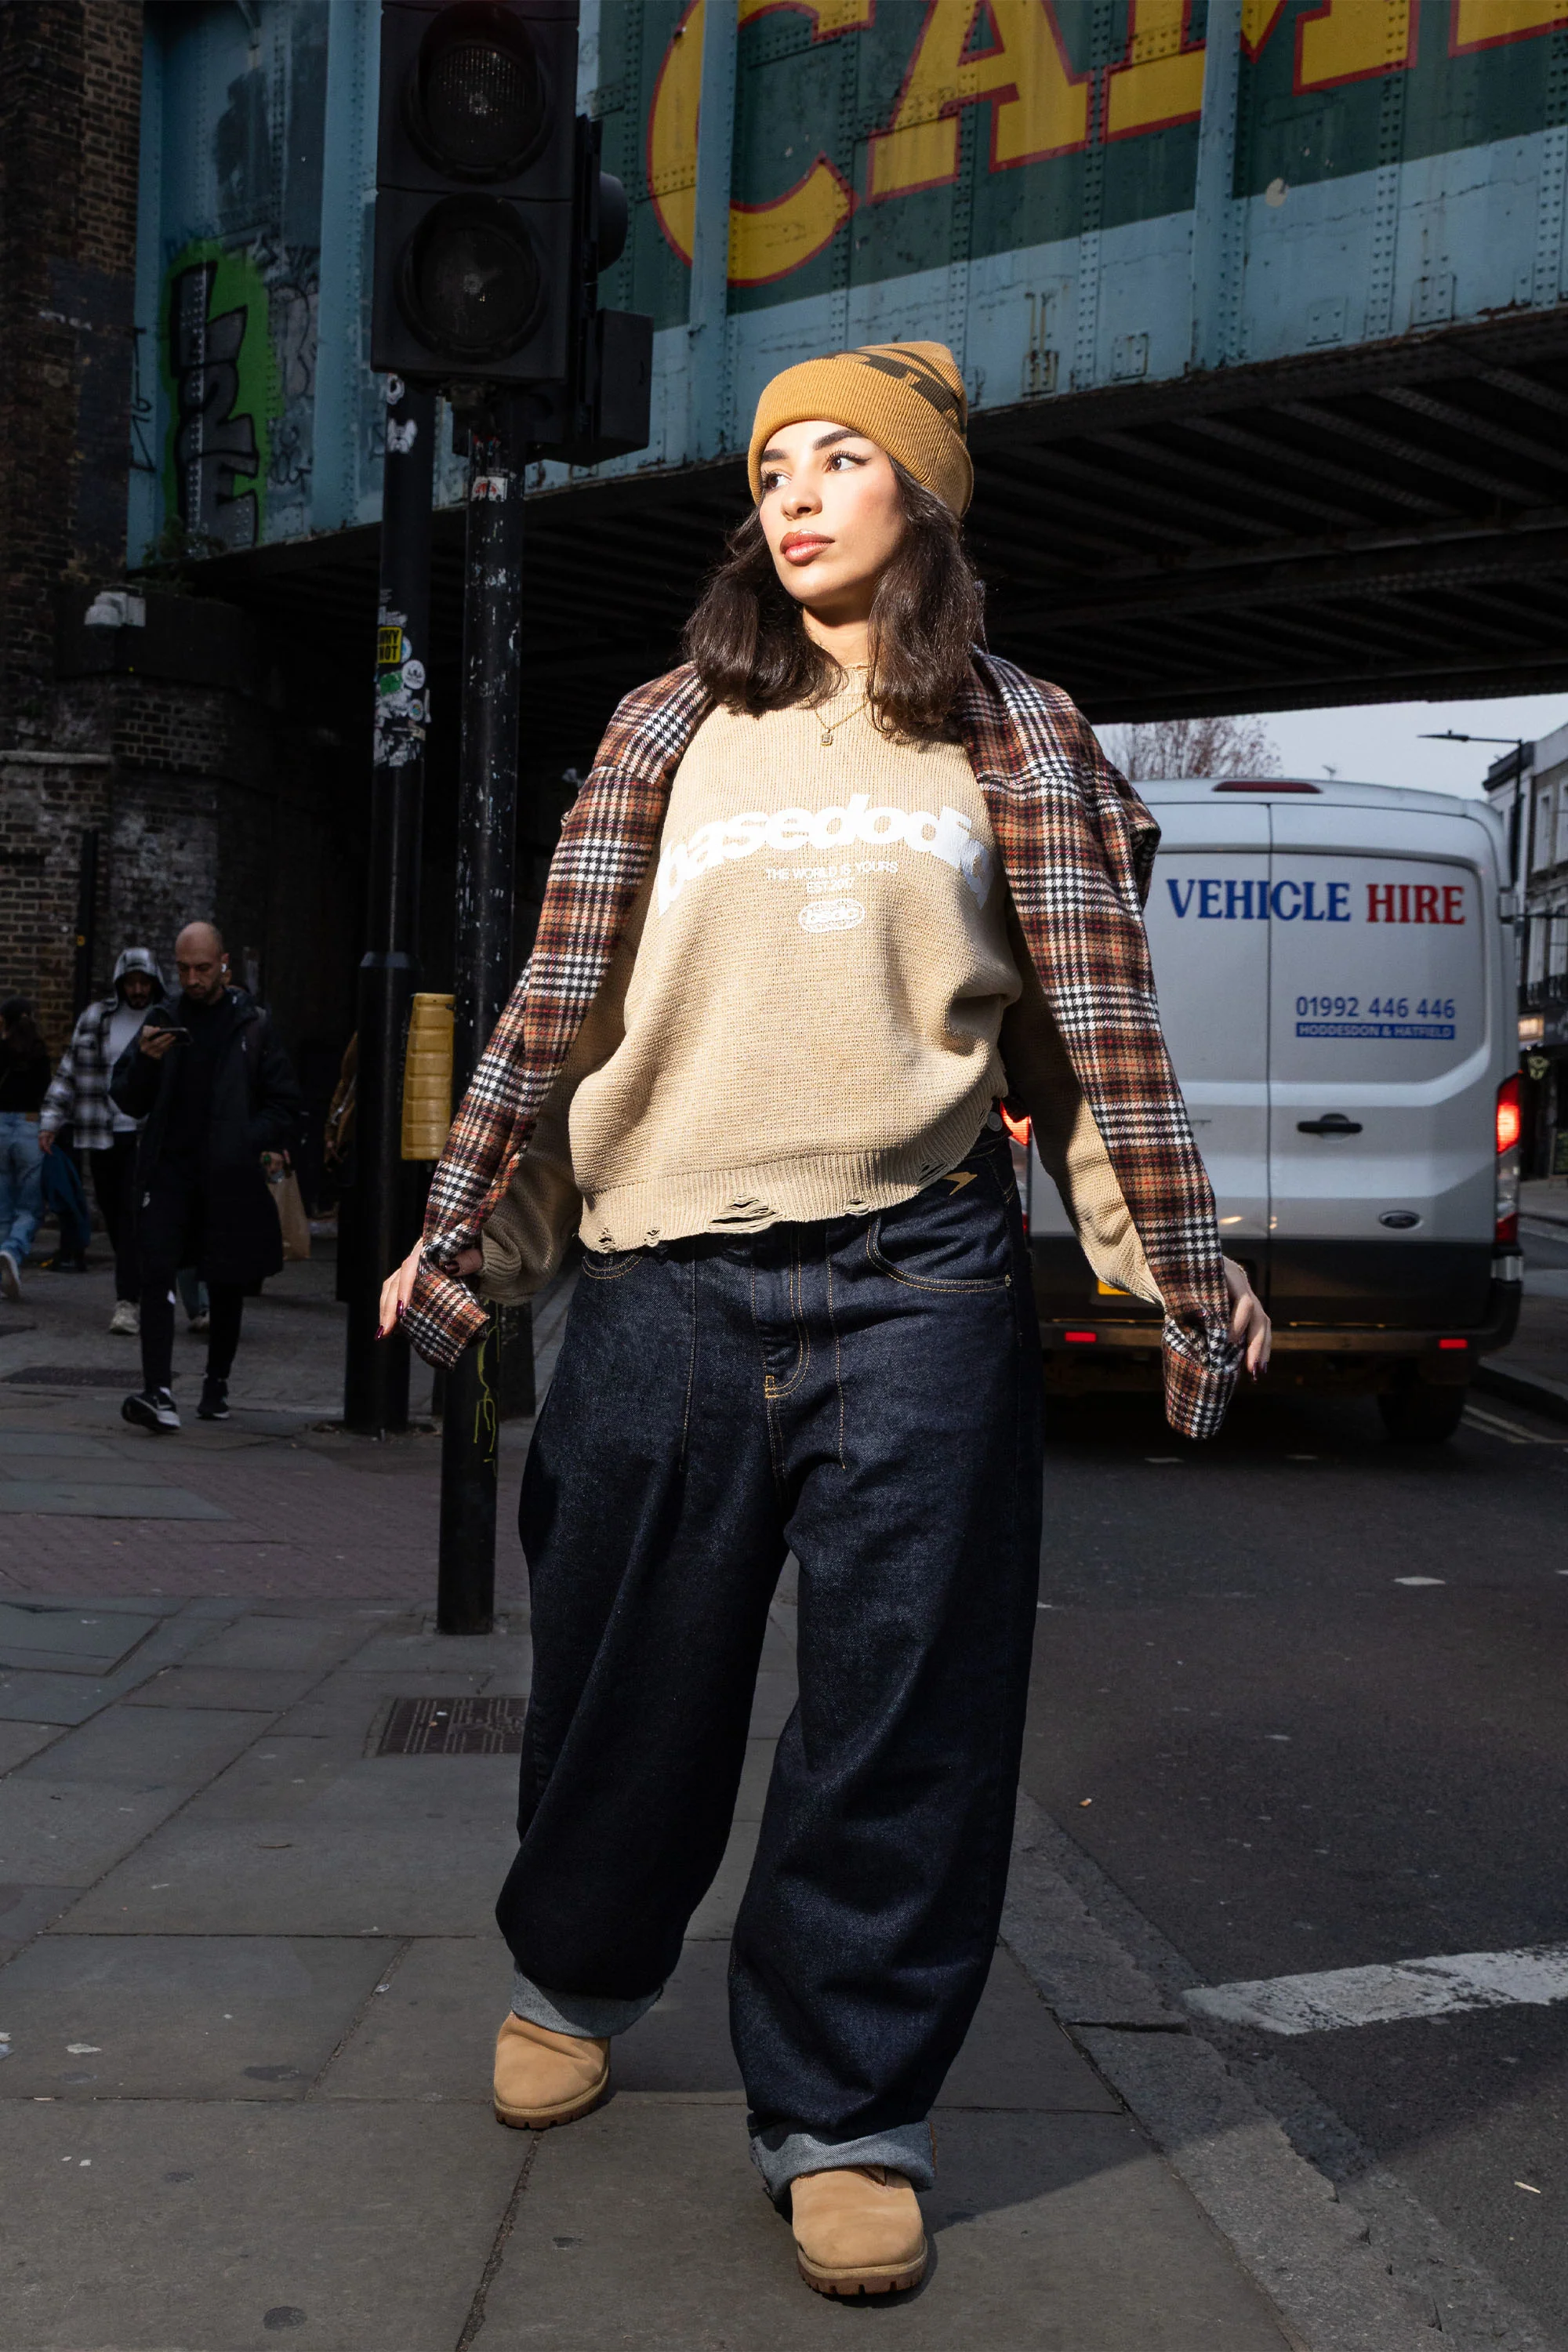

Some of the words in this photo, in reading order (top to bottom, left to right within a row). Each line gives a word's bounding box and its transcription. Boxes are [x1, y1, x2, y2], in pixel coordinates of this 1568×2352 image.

[766, 868, 789, 880] THE
[792, 866, 837, 879] WORLD
[840, 864, 851, 876] IS
[855, 861, 898, 873] YOURS
[1167, 879, 1350, 921] VEHICLE
[1367, 884, 1465, 925] HIRE
[1296, 996, 1359, 1017] 01992
[1369, 998, 1408, 1018] 446
[1417, 999, 1455, 1018] 446
[1299, 1025, 1380, 1036] HODDESDON
[1381, 1025, 1392, 1036] &
[1395, 1026, 1451, 1037] HATFIELD
